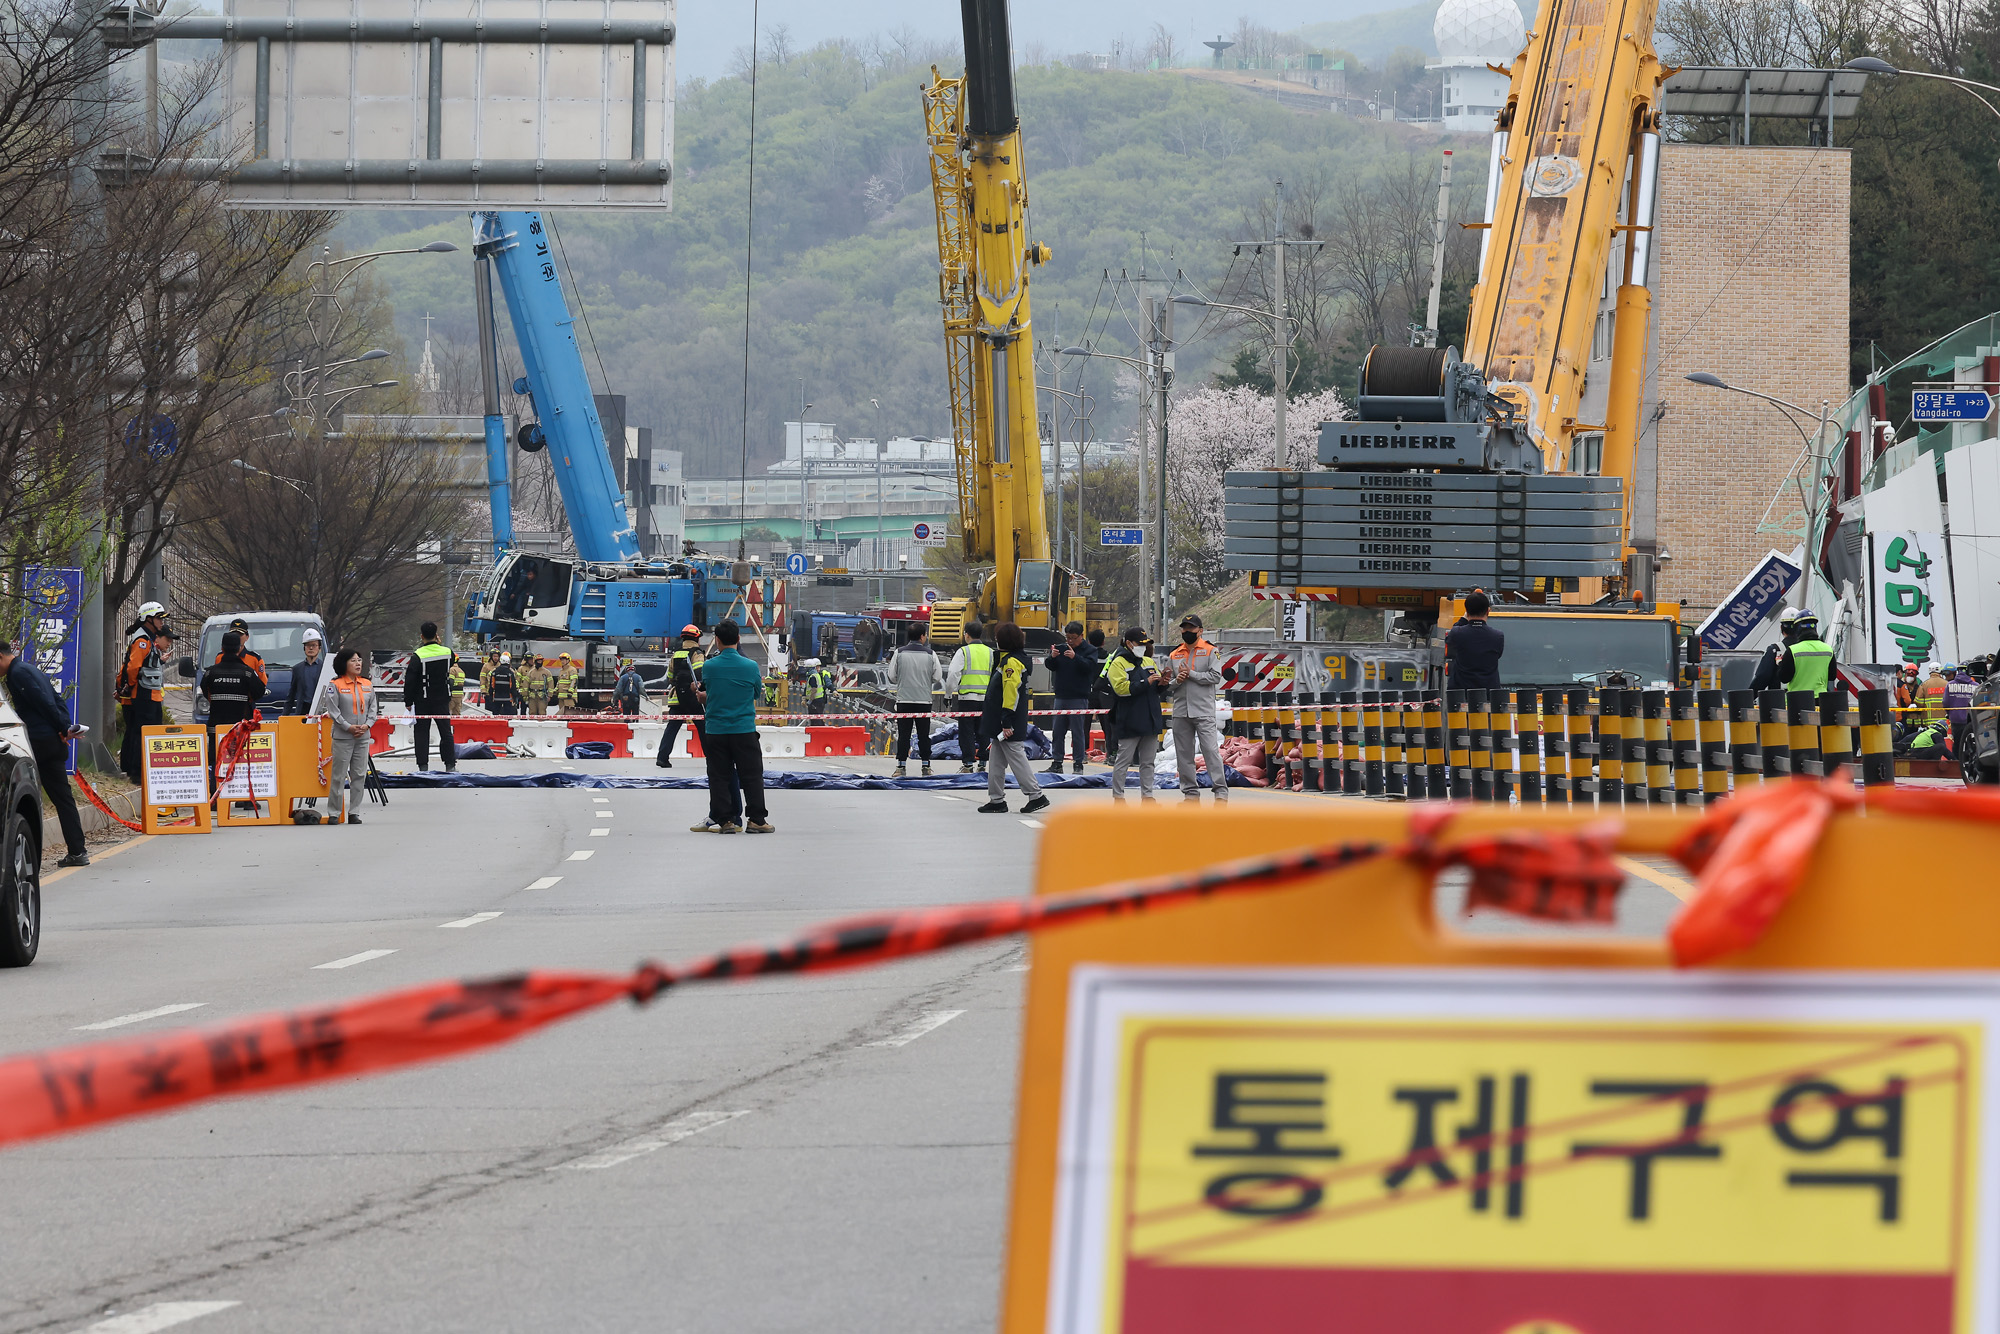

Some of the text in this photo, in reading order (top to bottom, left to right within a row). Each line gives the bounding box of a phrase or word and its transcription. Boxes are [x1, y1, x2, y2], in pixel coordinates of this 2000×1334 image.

[1916, 394, 1957, 408] 양달로
[1915, 409, 1961, 418] Yangdal-ro
[1340, 435, 1456, 449] LIEBHERR
[1360, 476, 1432, 487] LIEBHERR
[1360, 493, 1432, 504] LIEBHERR
[1360, 510, 1432, 521] LIEBHERR
[1103, 530, 1126, 538] 오리로
[1360, 527, 1432, 538] LIEBHERR
[1359, 544, 1431, 555] LIEBHERR
[1359, 560, 1431, 571] LIEBHERR
[153, 740, 197, 751] 통제구역
[1192, 1072, 1906, 1222] 통제구역
